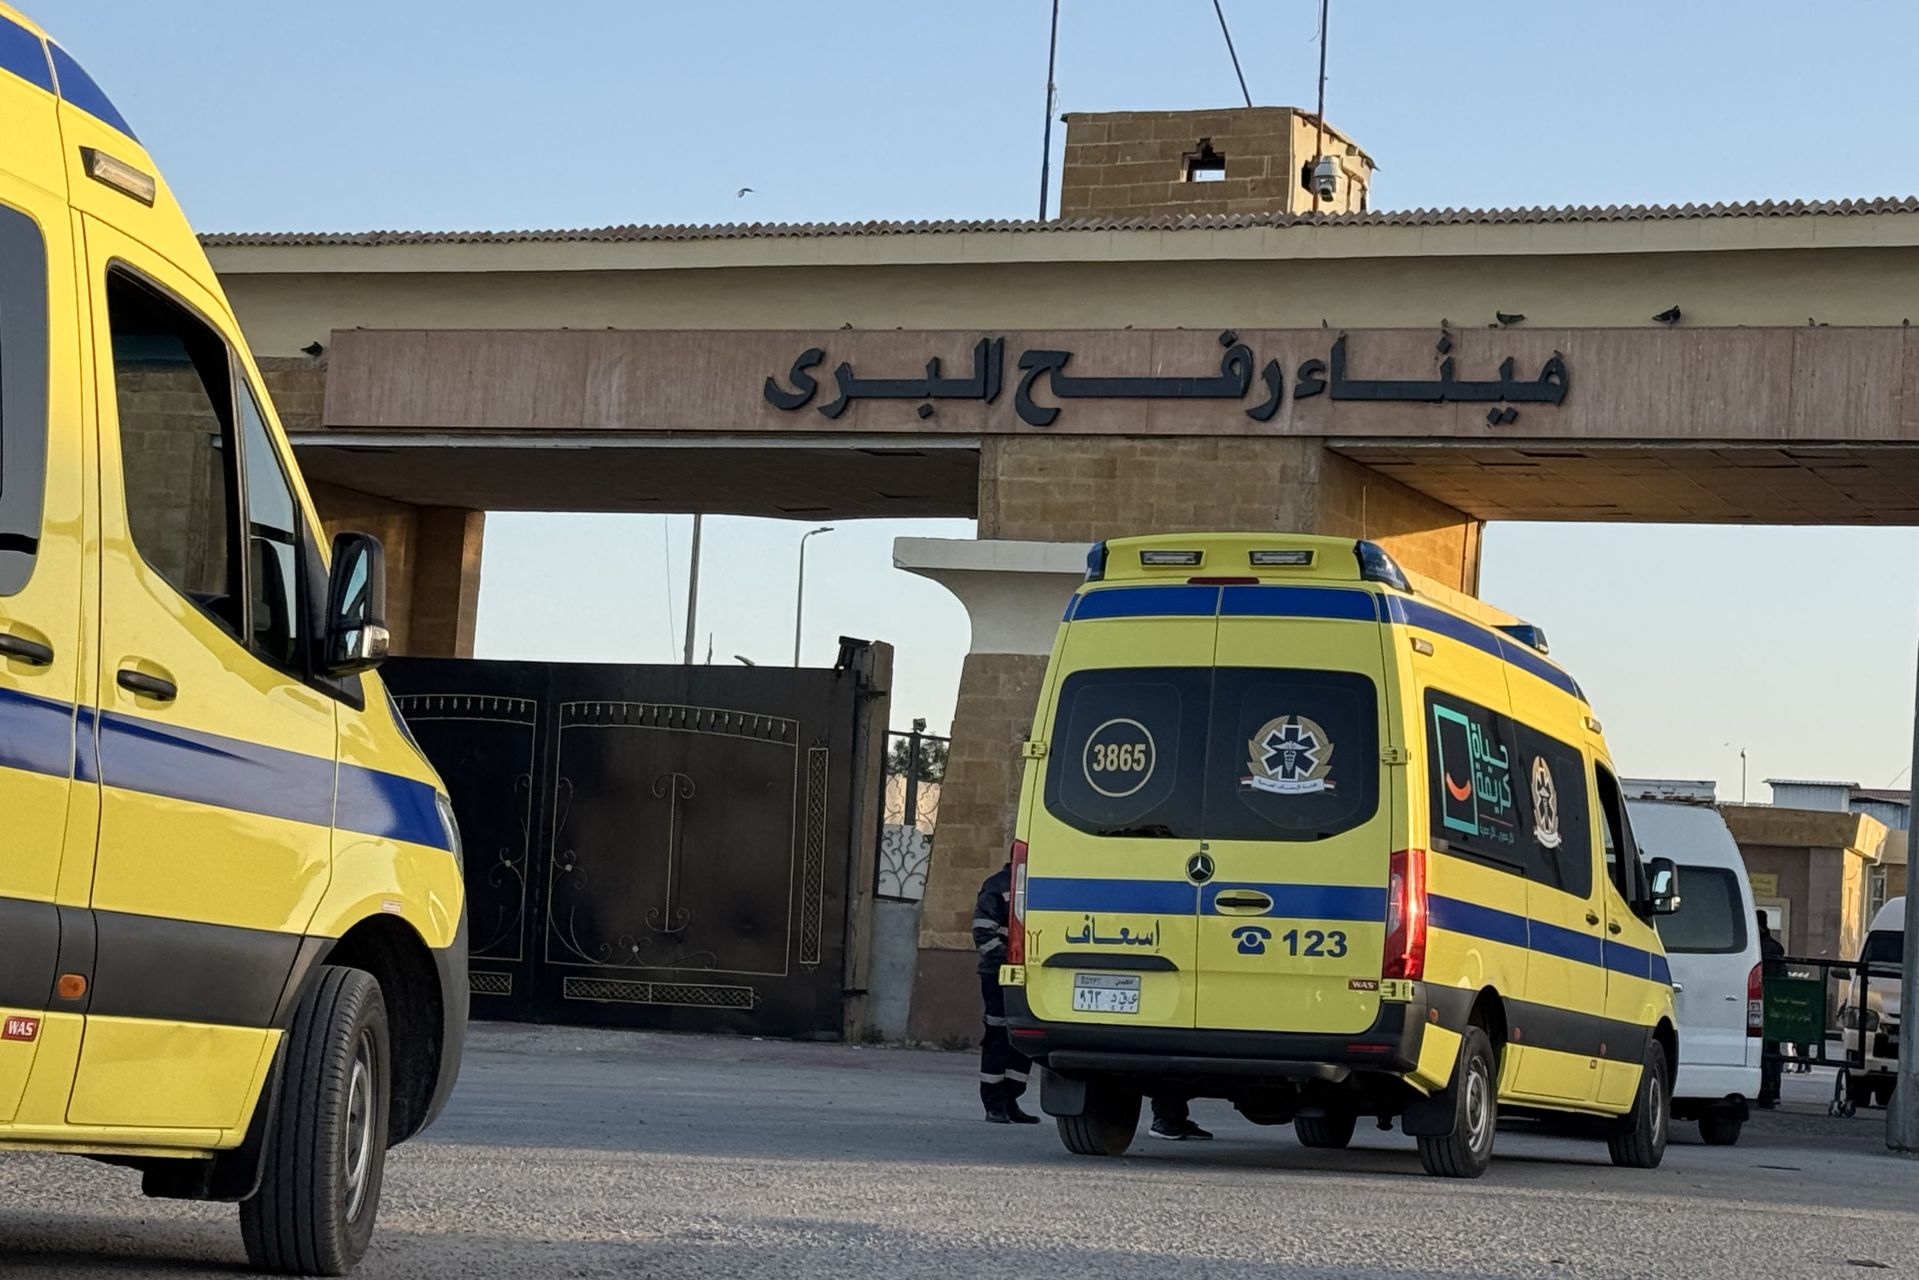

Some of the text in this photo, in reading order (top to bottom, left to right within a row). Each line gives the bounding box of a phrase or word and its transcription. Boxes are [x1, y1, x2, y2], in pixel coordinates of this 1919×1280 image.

[764, 330, 1569, 427] ميناء رفح البرى
[1093, 744, 1146, 772] 3865
[1471, 723, 1509, 774] حياة
[1476, 762, 1511, 815] كريمة
[1065, 914, 1160, 953] إسعاف
[1282, 929, 1348, 957] 123
[1352, 981, 1375, 989] WAS
[8, 1020, 34, 1036] WAS
